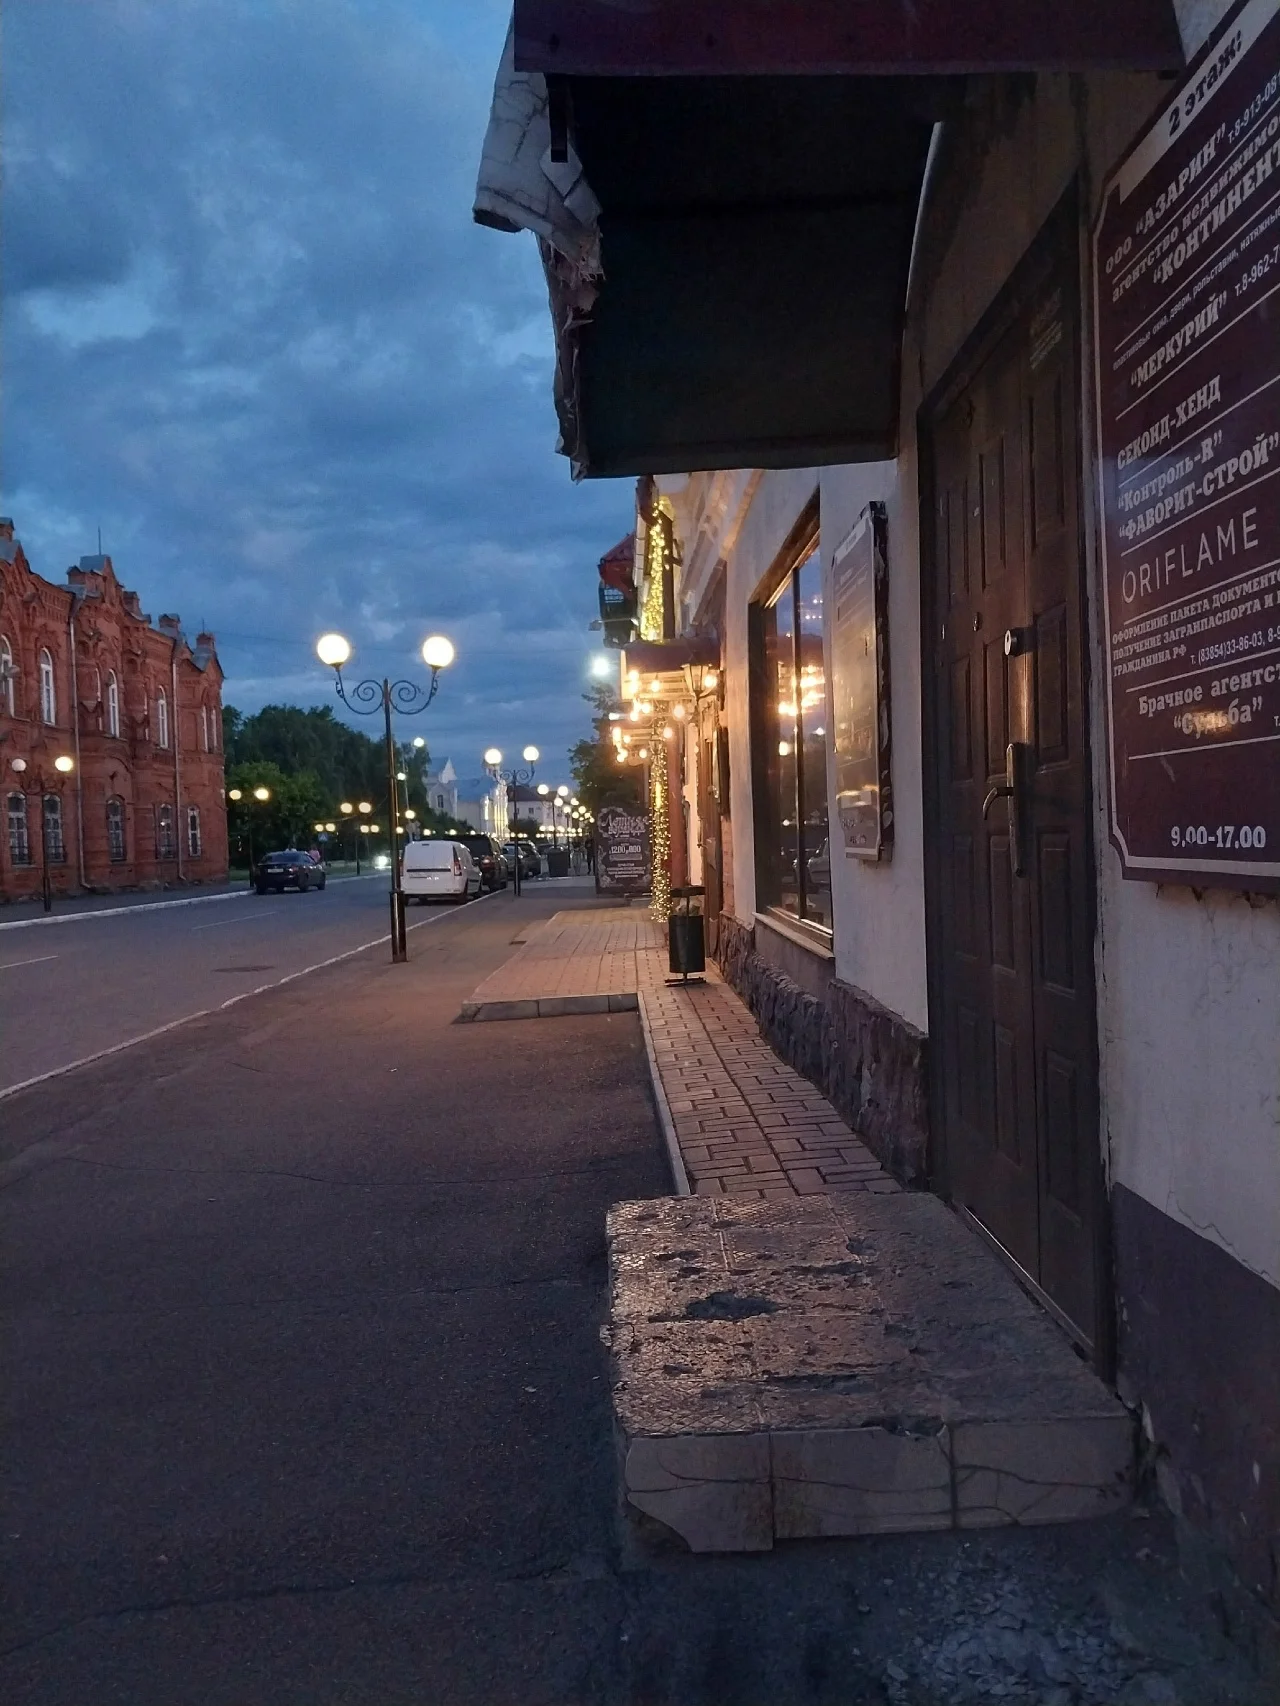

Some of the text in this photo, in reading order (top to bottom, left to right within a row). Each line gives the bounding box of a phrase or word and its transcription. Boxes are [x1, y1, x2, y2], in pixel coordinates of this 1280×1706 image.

[1169, 30, 1242, 137] 2 этаж:
[1105, 236, 1132, 274] ООО
[1228, 68, 1280, 143] т.8-913-08
[1112, 113, 1280, 302] агентство недвижимо
[1131, 290, 1227, 388] “МЕРКУРИЙ”
[1235, 244, 1280, 296] т.8-962-7
[1117, 374, 1221, 470] СЕКОНД-ХЕНД
[1119, 431, 1279, 540] “ФАВОРИТ-СТРОЙ”
[1122, 507, 1259, 604] ORIFLAME
[1112, 614, 1168, 644] ОФОРМЛЕНИЕ
[1170, 598, 1210, 624] ПАКЕТА
[1113, 635, 1161, 661] ПОЛУЧЕНИЕ
[1163, 598, 1261, 643] ЗАГРАНПАСПОРТА
[1264, 593, 1274, 608] И
[1113, 649, 1171, 677] ГРАЖДАНИНА
[1172, 644, 1187, 659] РФ
[1139, 684, 1203, 717] Брачное
[1171, 825, 1266, 849] 9.00-17.00
